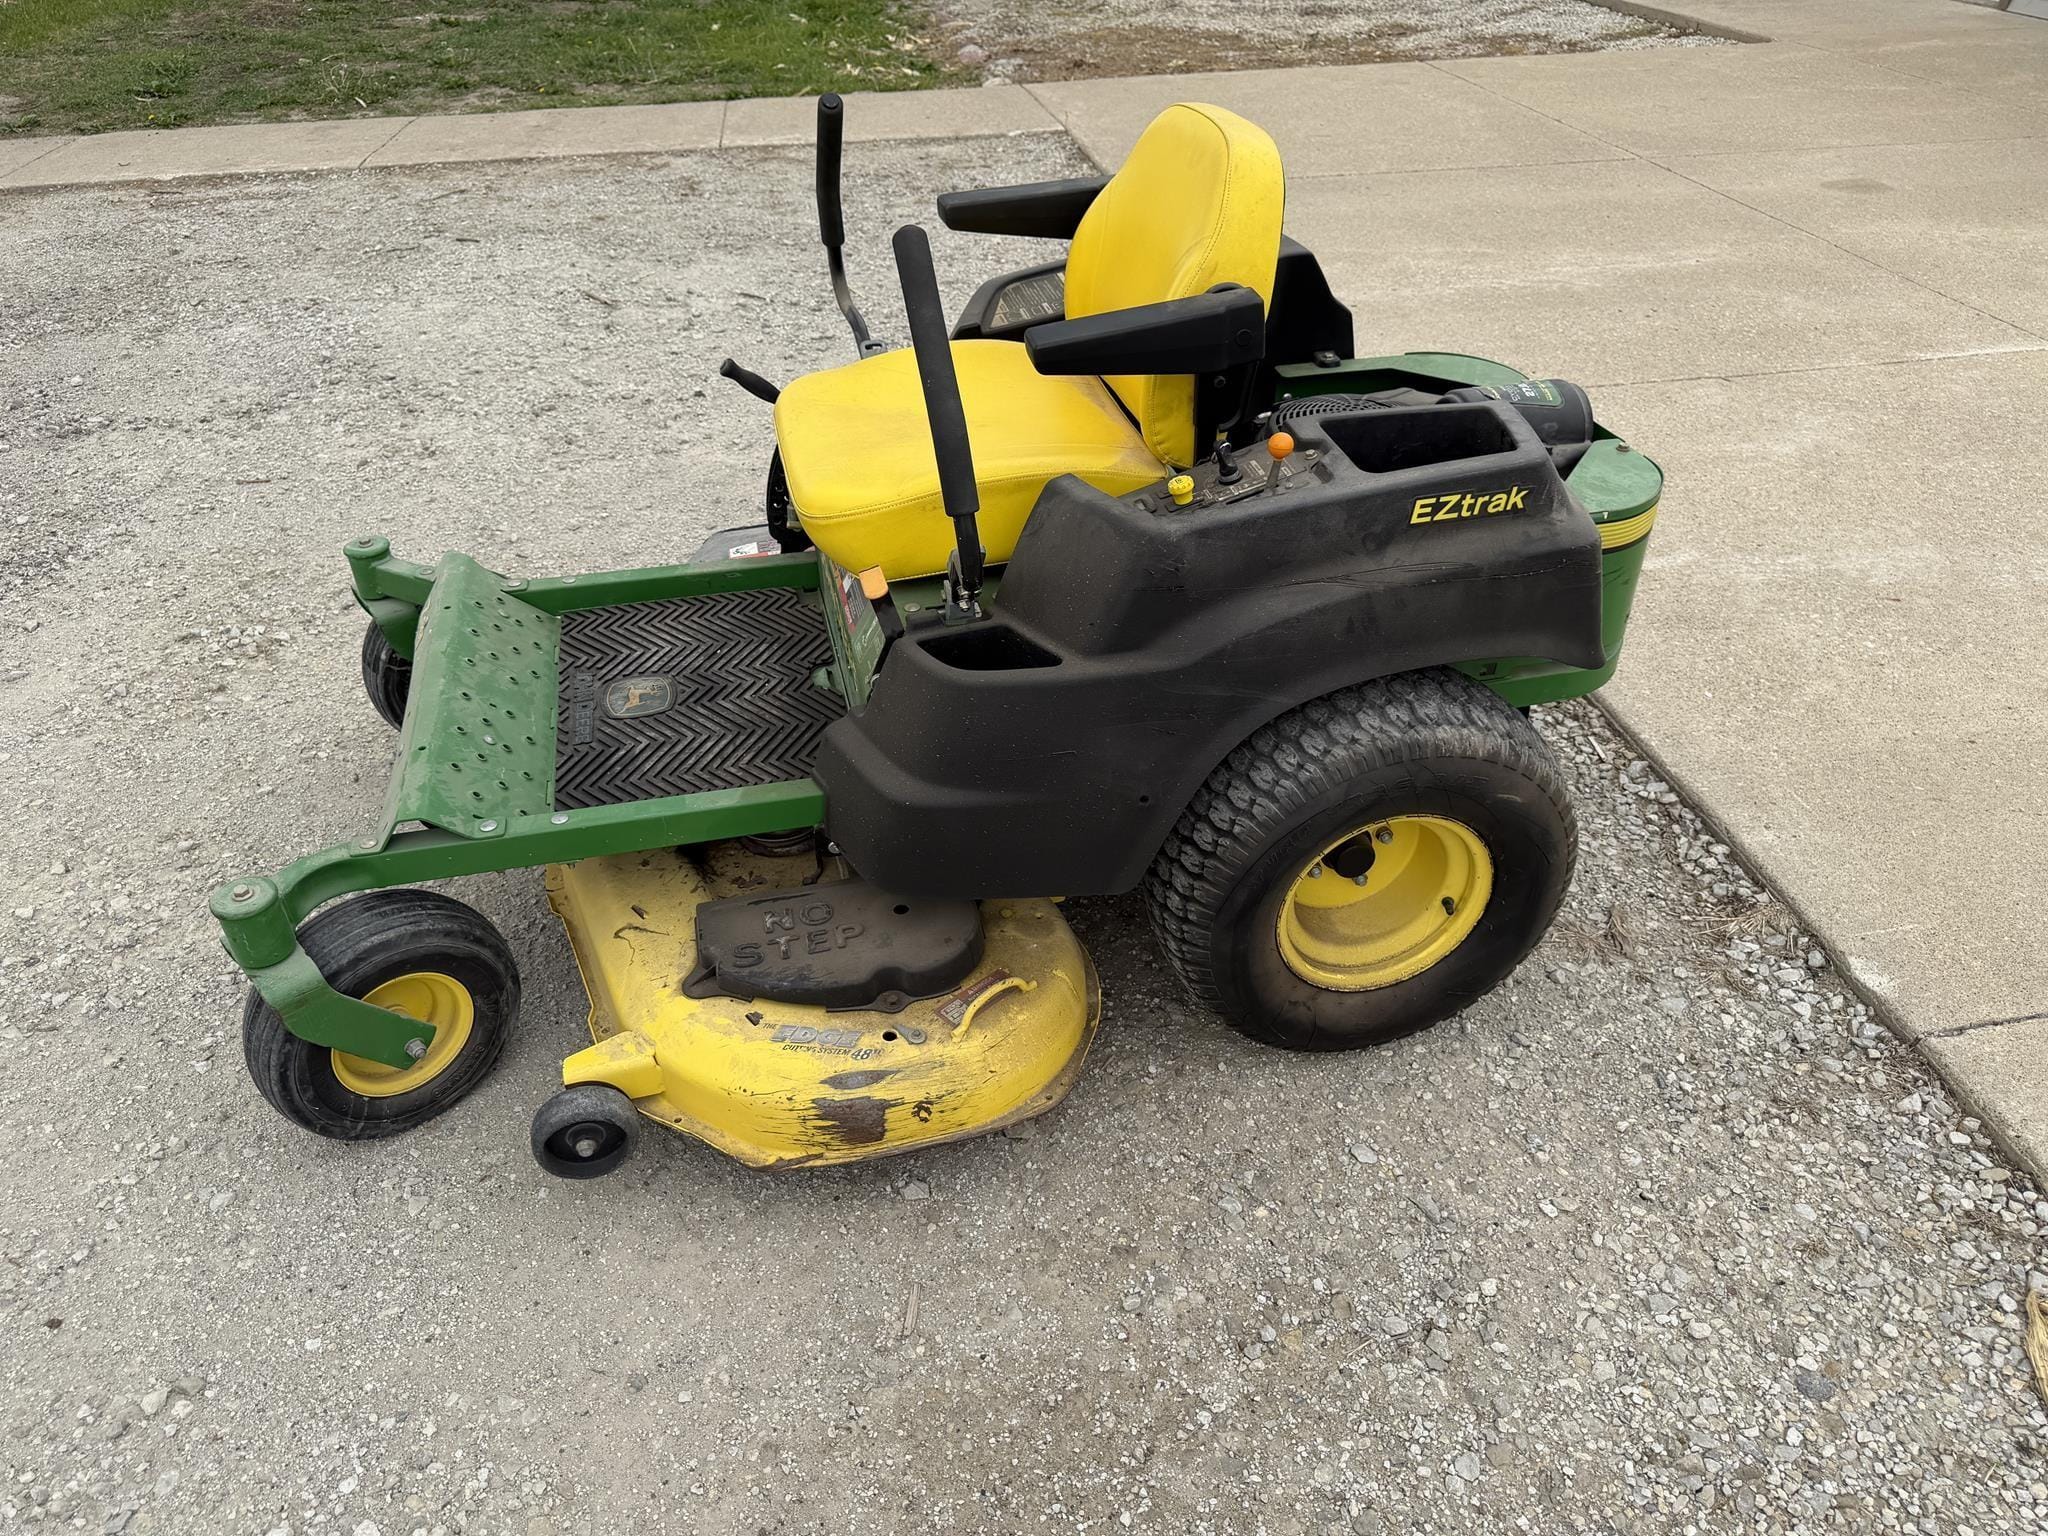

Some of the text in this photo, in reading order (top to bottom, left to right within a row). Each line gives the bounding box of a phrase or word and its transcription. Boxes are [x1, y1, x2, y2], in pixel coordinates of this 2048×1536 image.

[1410, 486, 1529, 524] EZtrak
[763, 903, 833, 934] NO
[733, 922, 865, 968] STEP
[771, 1024, 861, 1048] EDGE
[817, 1046, 851, 1056] SYSTEM
